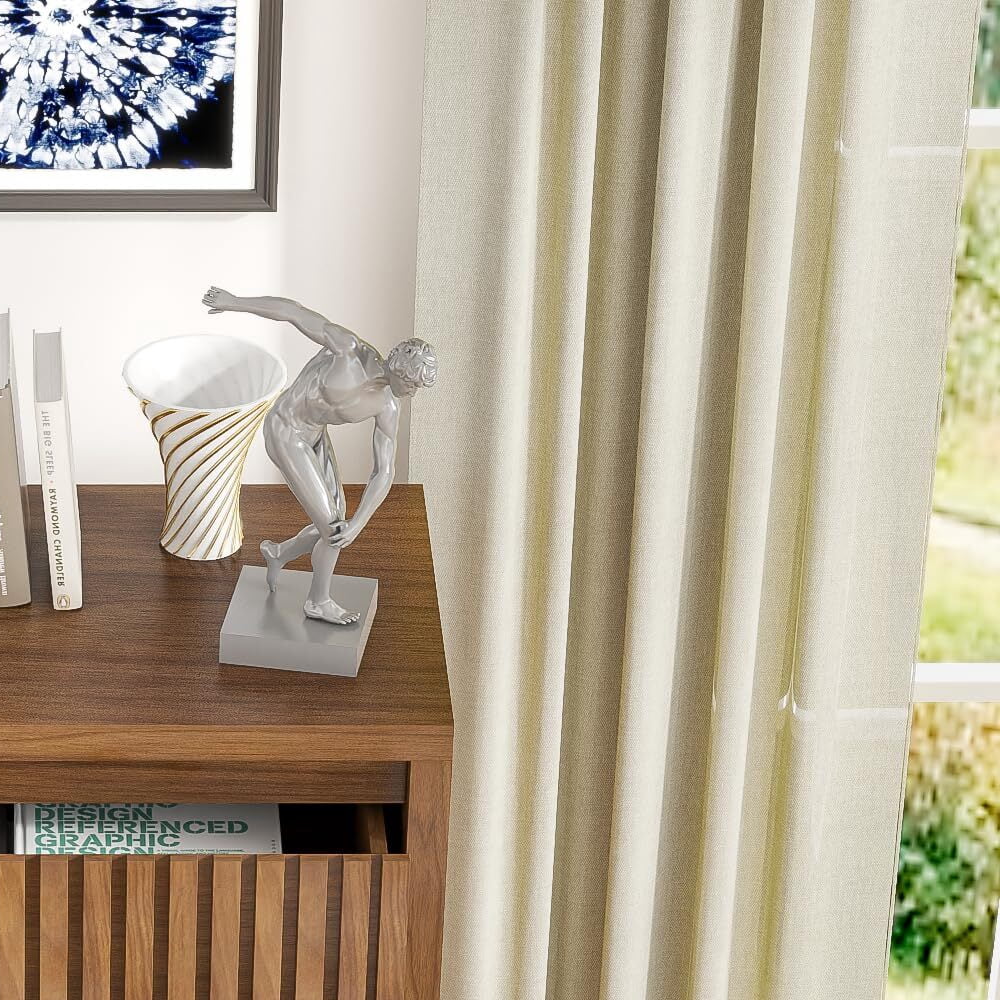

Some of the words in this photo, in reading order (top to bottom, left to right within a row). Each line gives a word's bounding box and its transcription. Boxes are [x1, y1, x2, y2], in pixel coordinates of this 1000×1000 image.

[34, 807, 153, 820] DESIGN
[34, 821, 249, 834] REFERENCED
[34, 834, 181, 847] GRAPHIC
